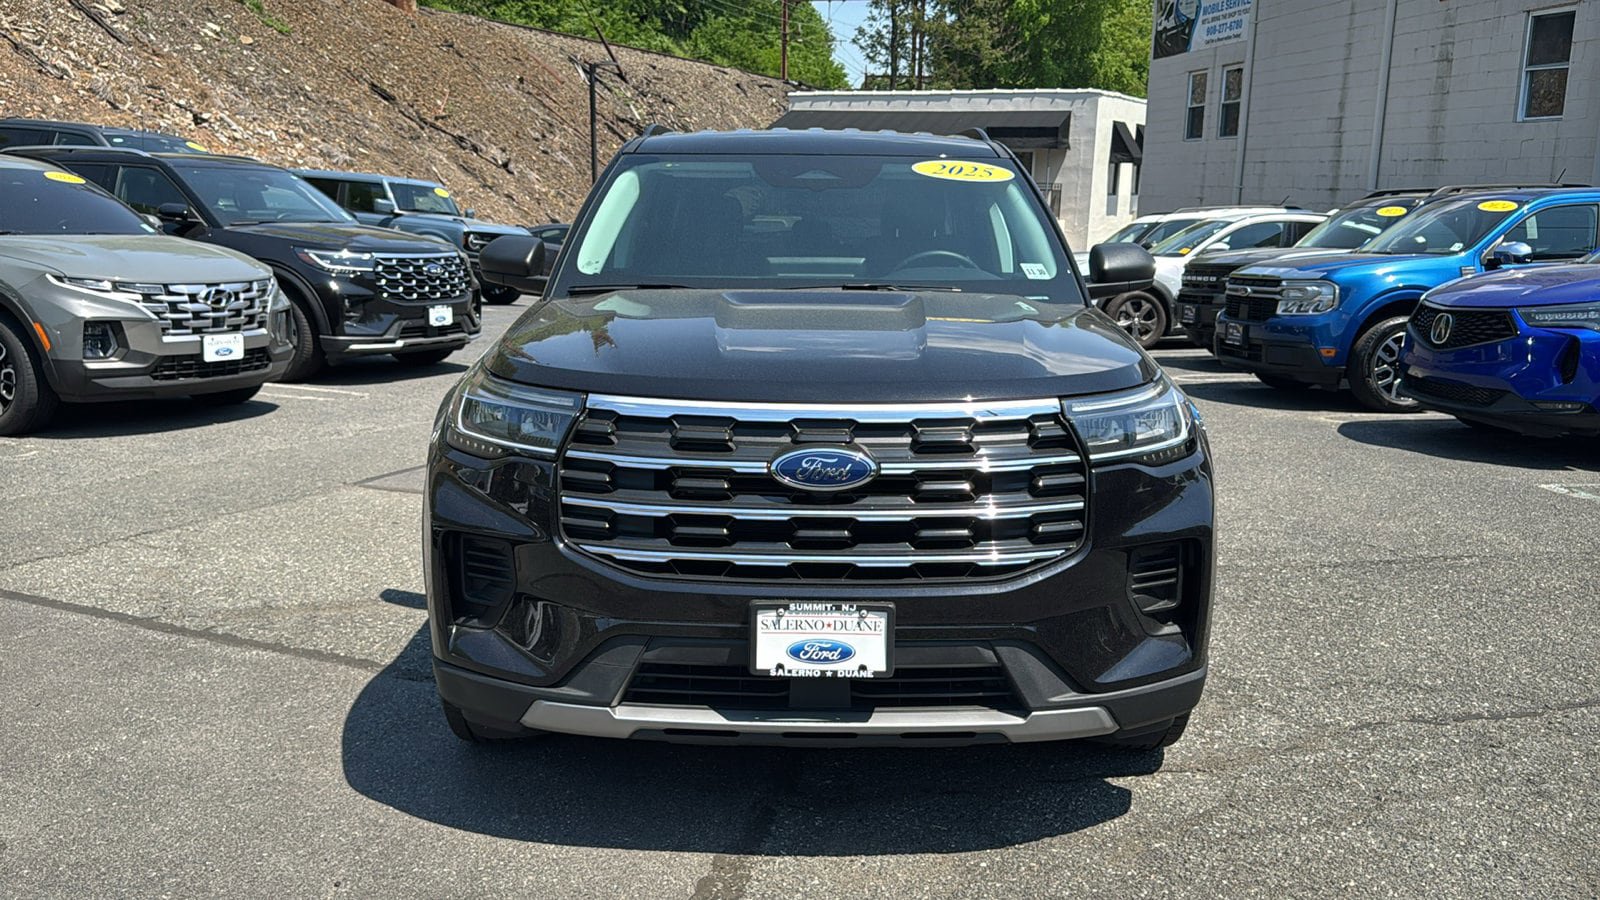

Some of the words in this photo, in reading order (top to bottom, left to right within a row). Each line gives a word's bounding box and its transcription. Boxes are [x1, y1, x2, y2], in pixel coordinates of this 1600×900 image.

[1202, 1, 1225, 16] MOBILE
[932, 164, 994, 178] 2025
[796, 456, 852, 480] Ford
[760, 619, 825, 631] SALERNO
[833, 620, 883, 632] DUANE
[800, 642, 841, 660] Ford
[769, 668, 821, 677] SALERNO
[837, 669, 874, 678] DUANE
